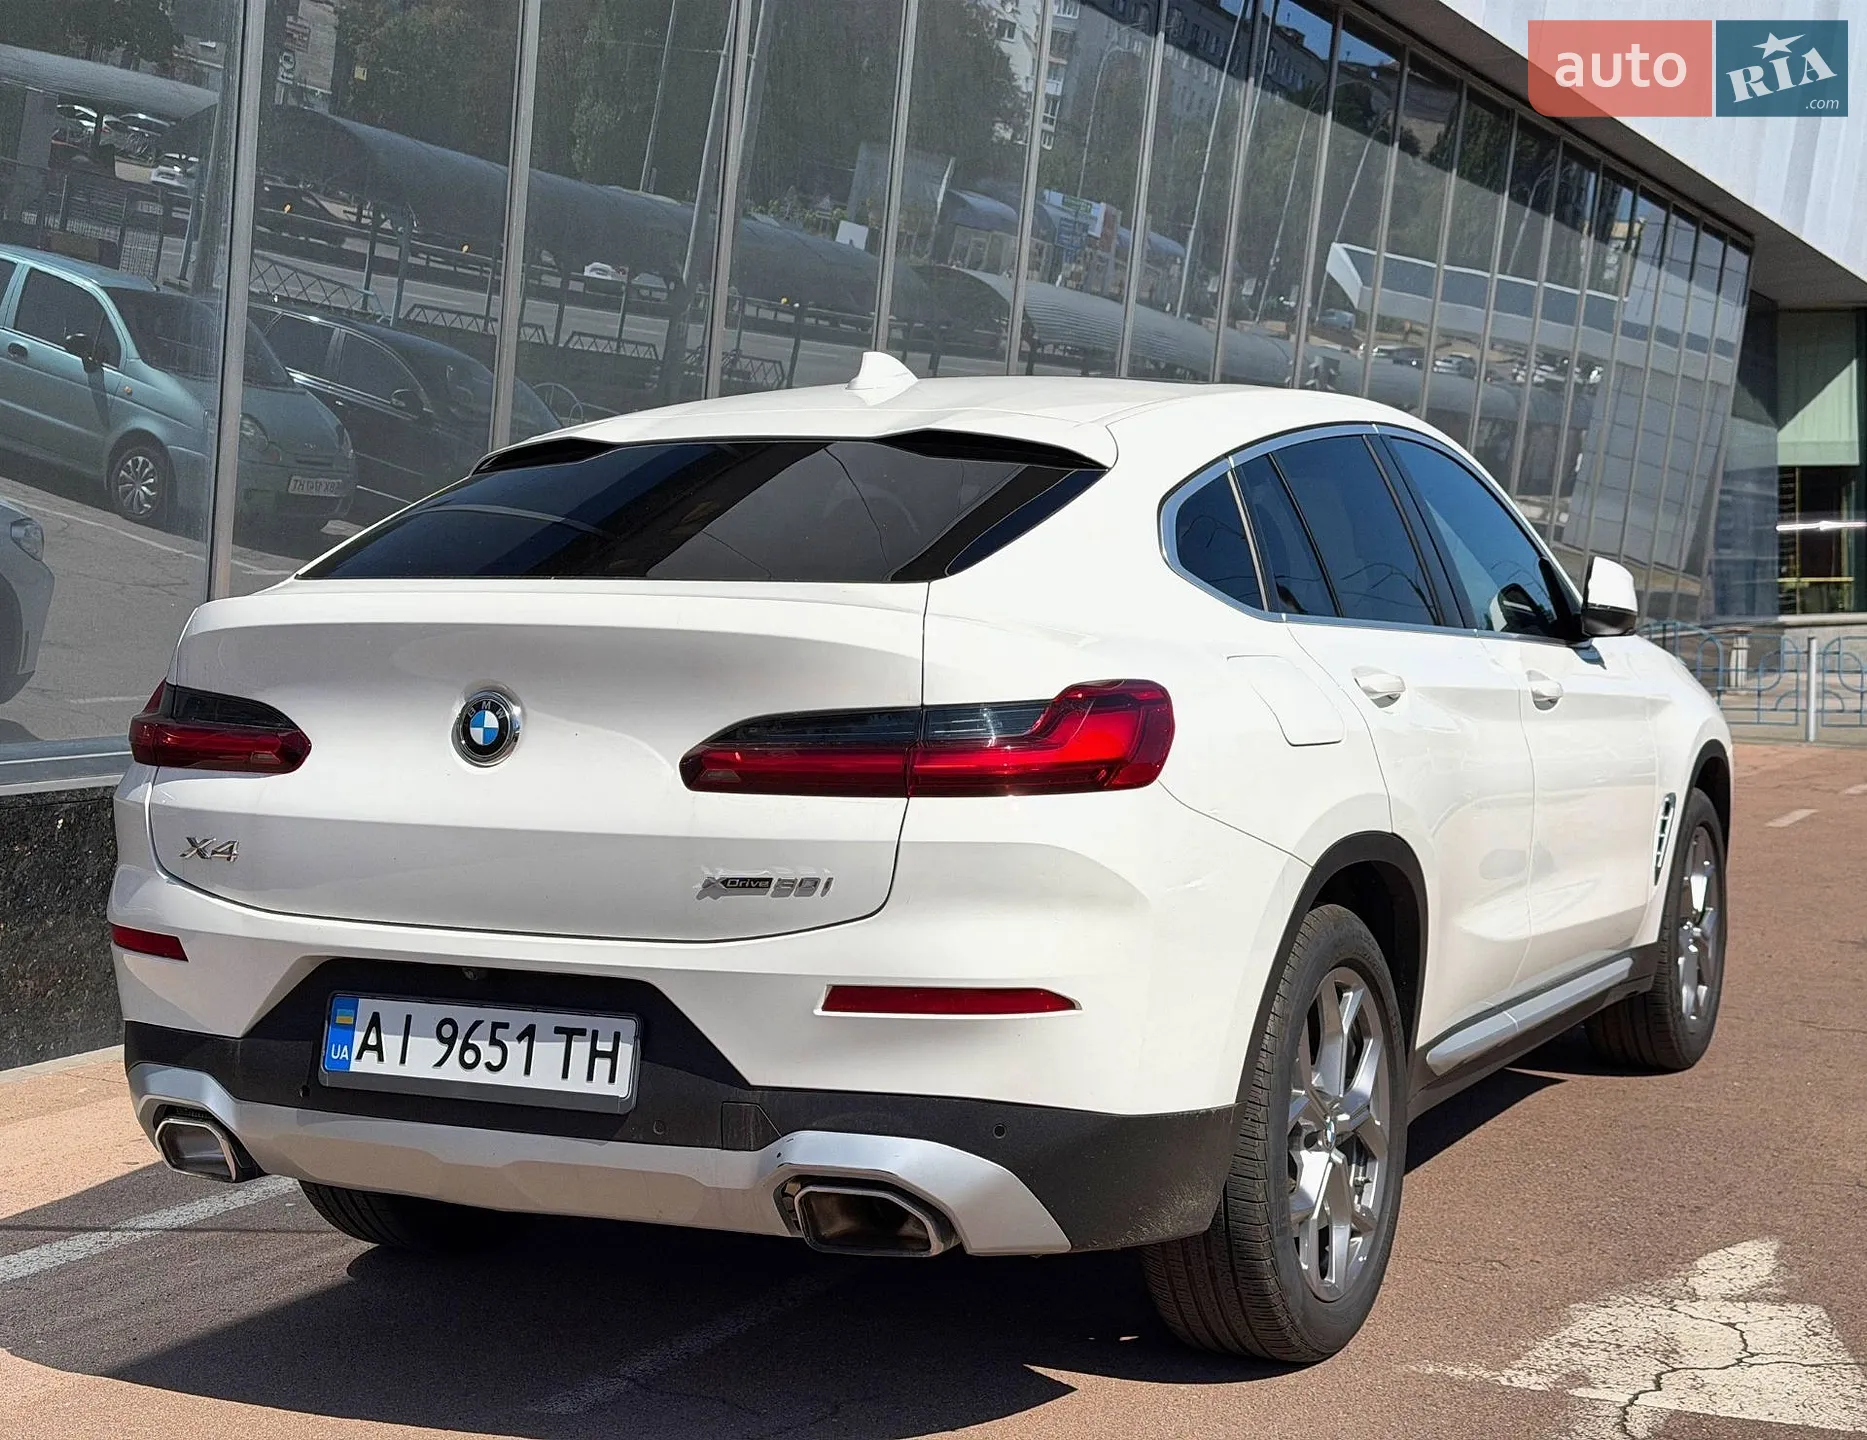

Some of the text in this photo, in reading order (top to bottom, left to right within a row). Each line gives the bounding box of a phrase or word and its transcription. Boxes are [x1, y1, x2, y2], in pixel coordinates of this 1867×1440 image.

[467, 700, 507, 720] BMW
[179, 835, 240, 862] X4
[331, 1043, 350, 1061] UA
[354, 1010, 622, 1085] AI 9651 TH
